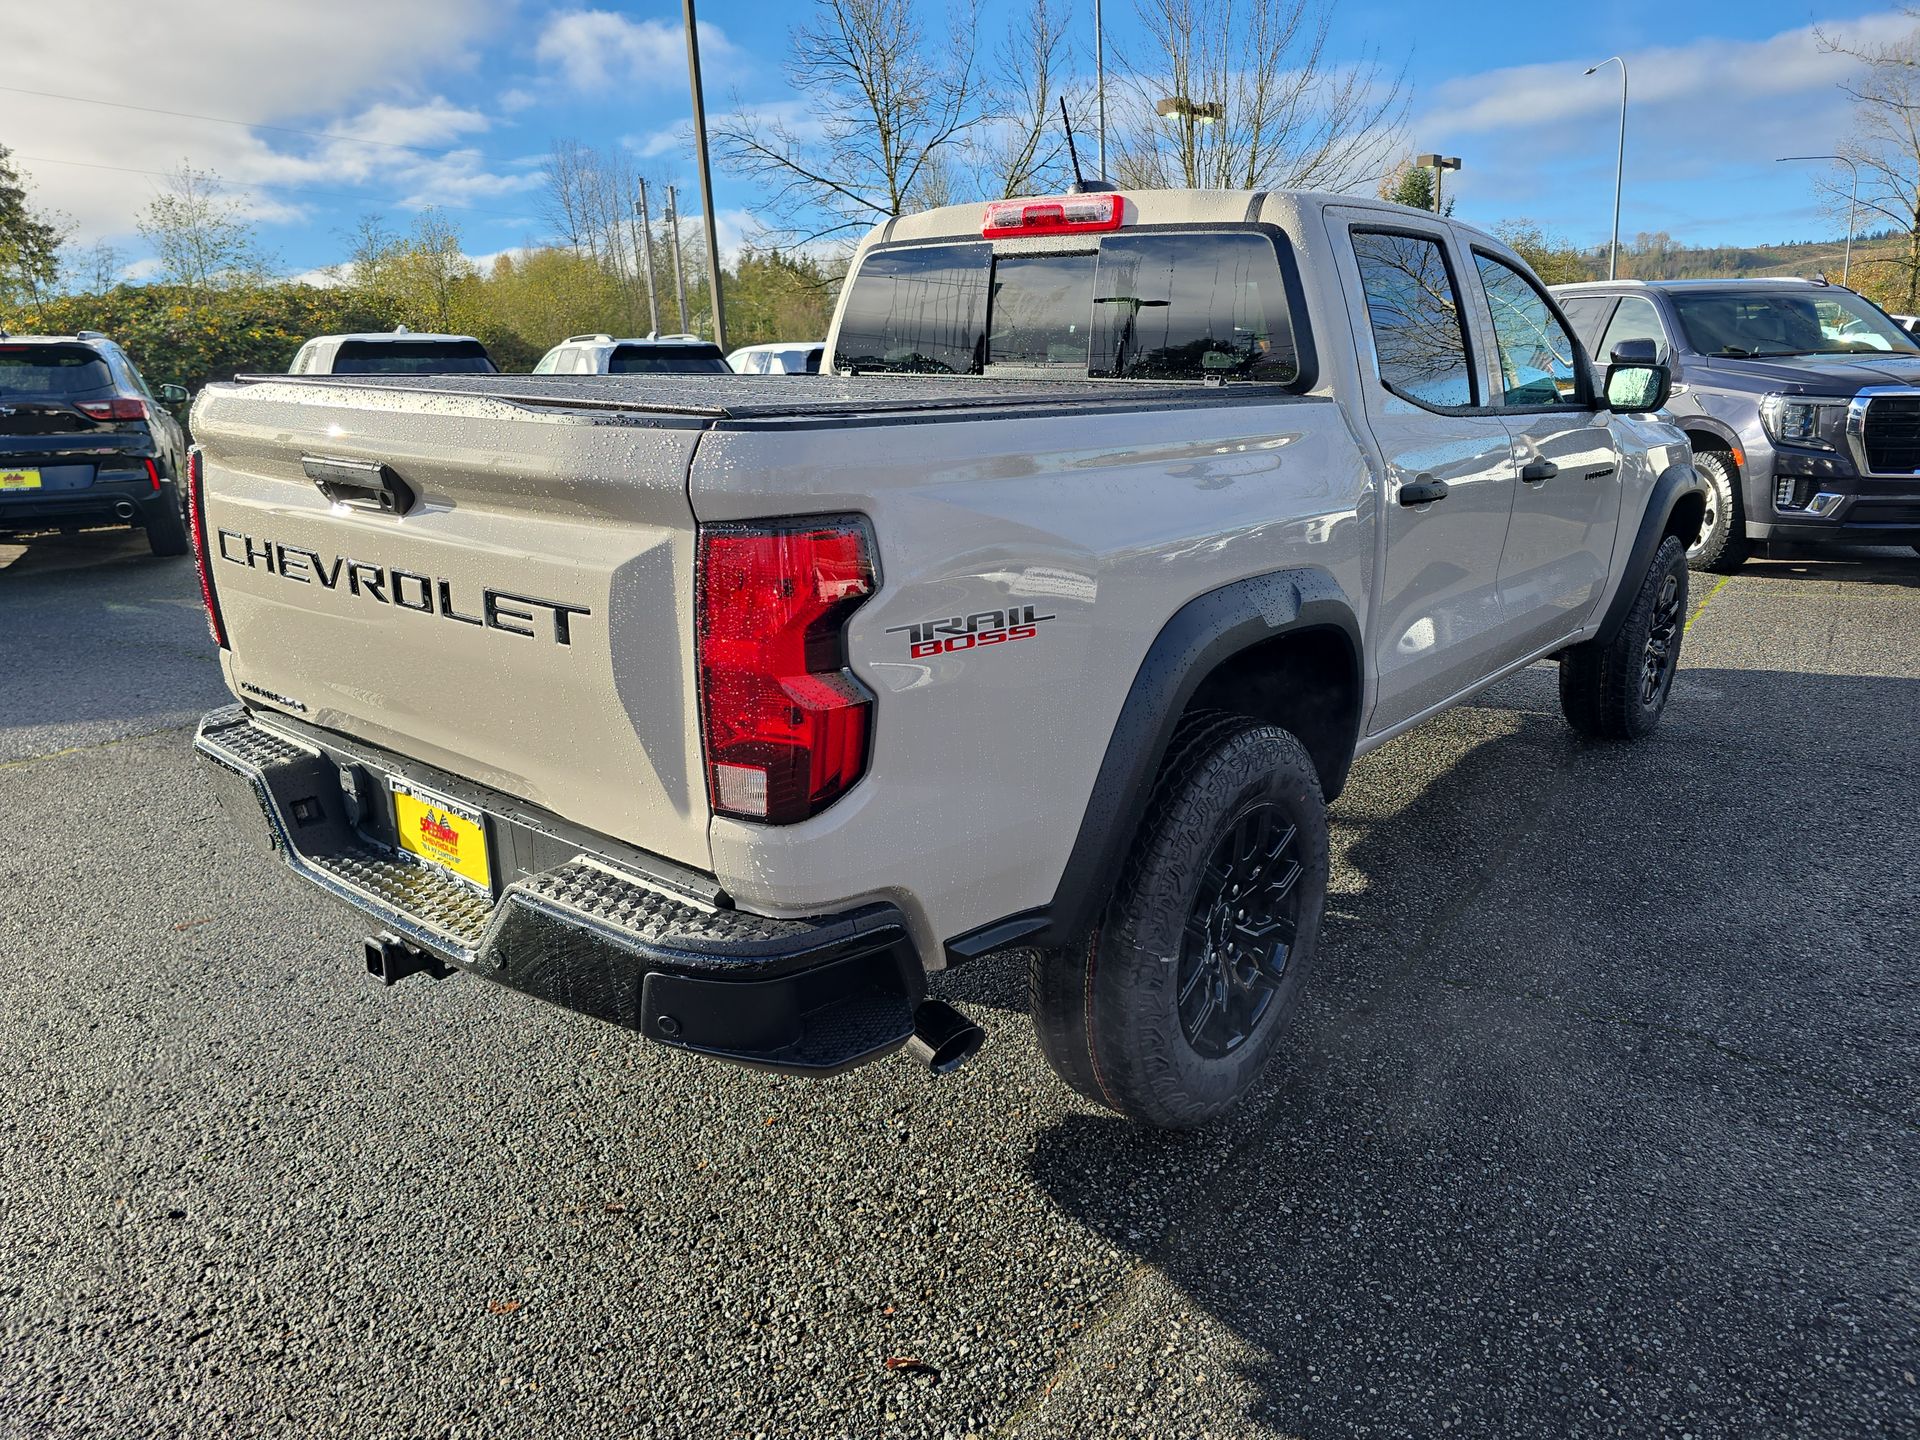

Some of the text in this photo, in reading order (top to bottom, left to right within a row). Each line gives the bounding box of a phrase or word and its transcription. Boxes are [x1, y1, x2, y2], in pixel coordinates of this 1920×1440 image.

[218, 528, 591, 646] CHEVROLET
[886, 605, 1056, 643] TRAIL
[911, 624, 1036, 659] BOSS
[420, 817, 459, 847] SPEEDWAY
[421, 833, 459, 856] CHEVROLET
